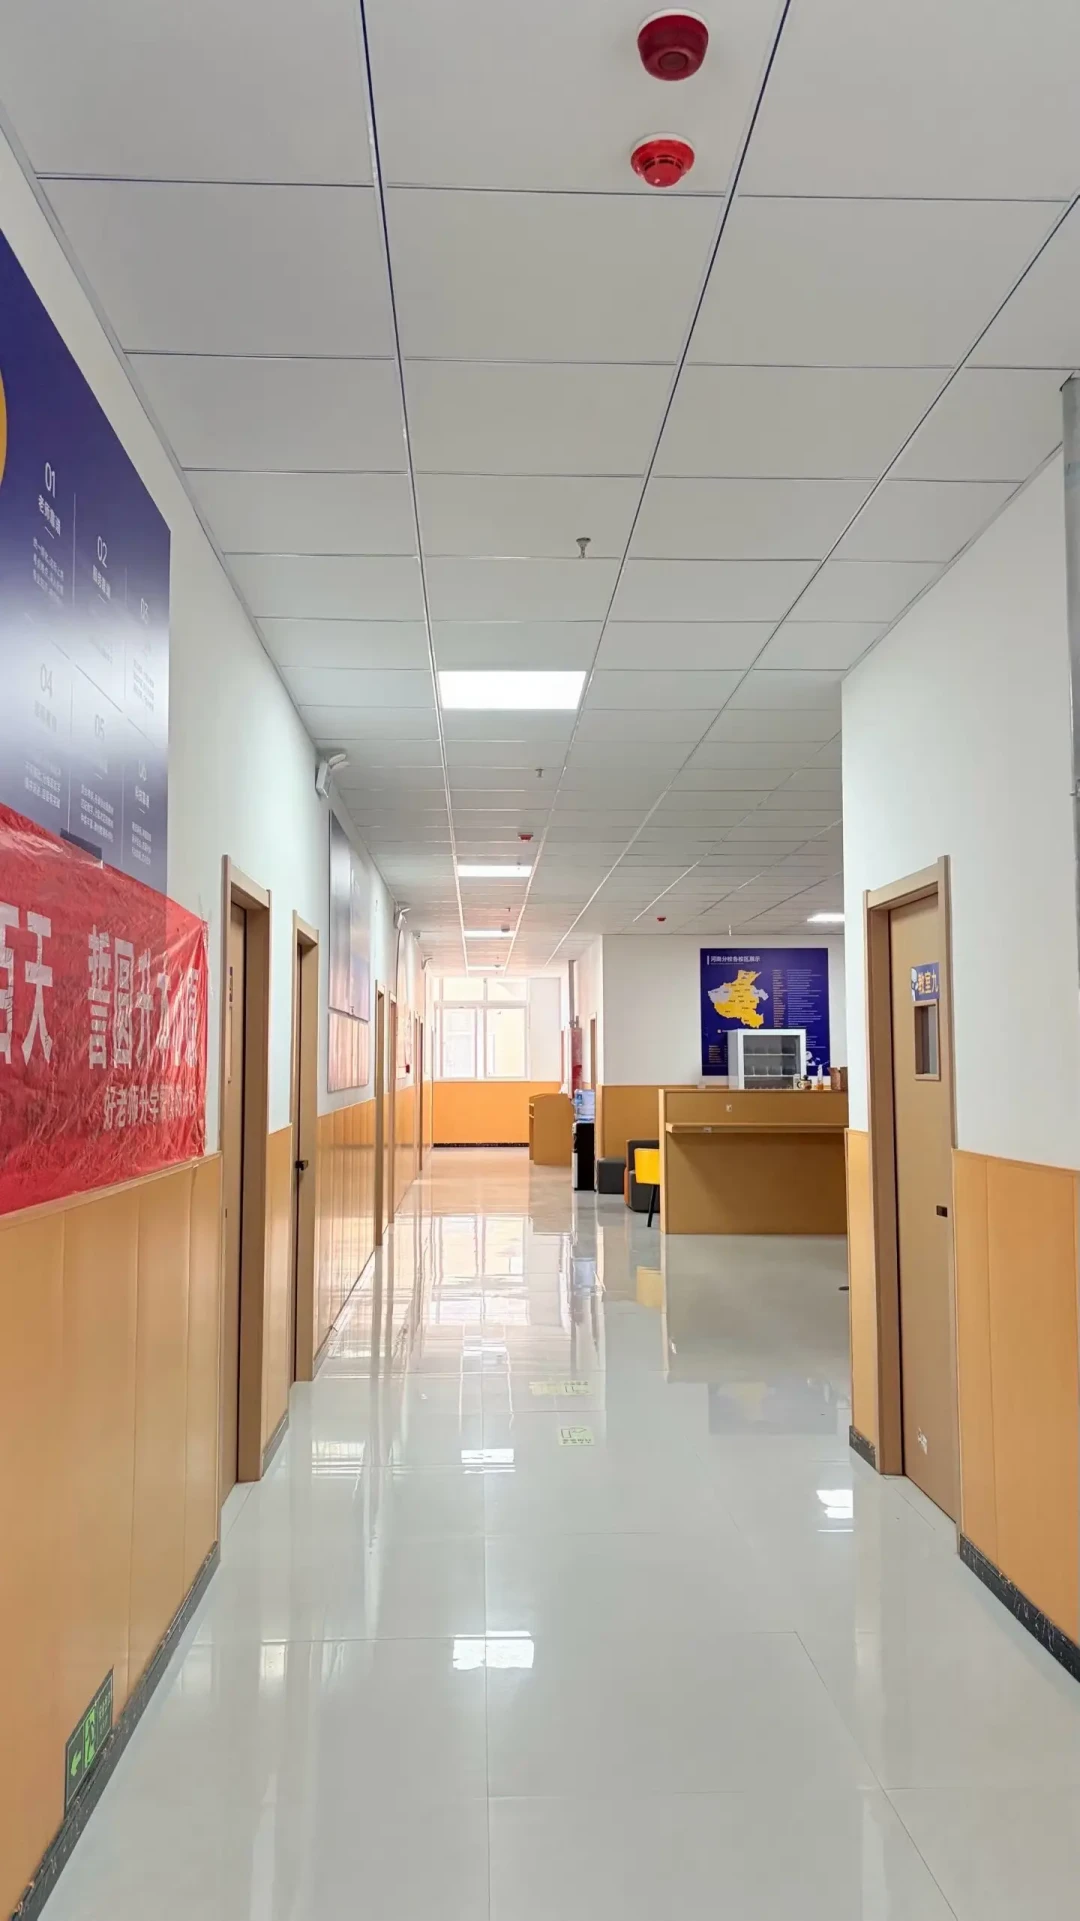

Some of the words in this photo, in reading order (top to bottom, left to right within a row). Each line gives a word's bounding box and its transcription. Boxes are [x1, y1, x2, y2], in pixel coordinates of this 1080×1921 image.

[45, 462, 56, 498] 01
[97, 535, 108, 568] 02
[40, 663, 53, 699] 04
[918, 969, 939, 995] 教室九
